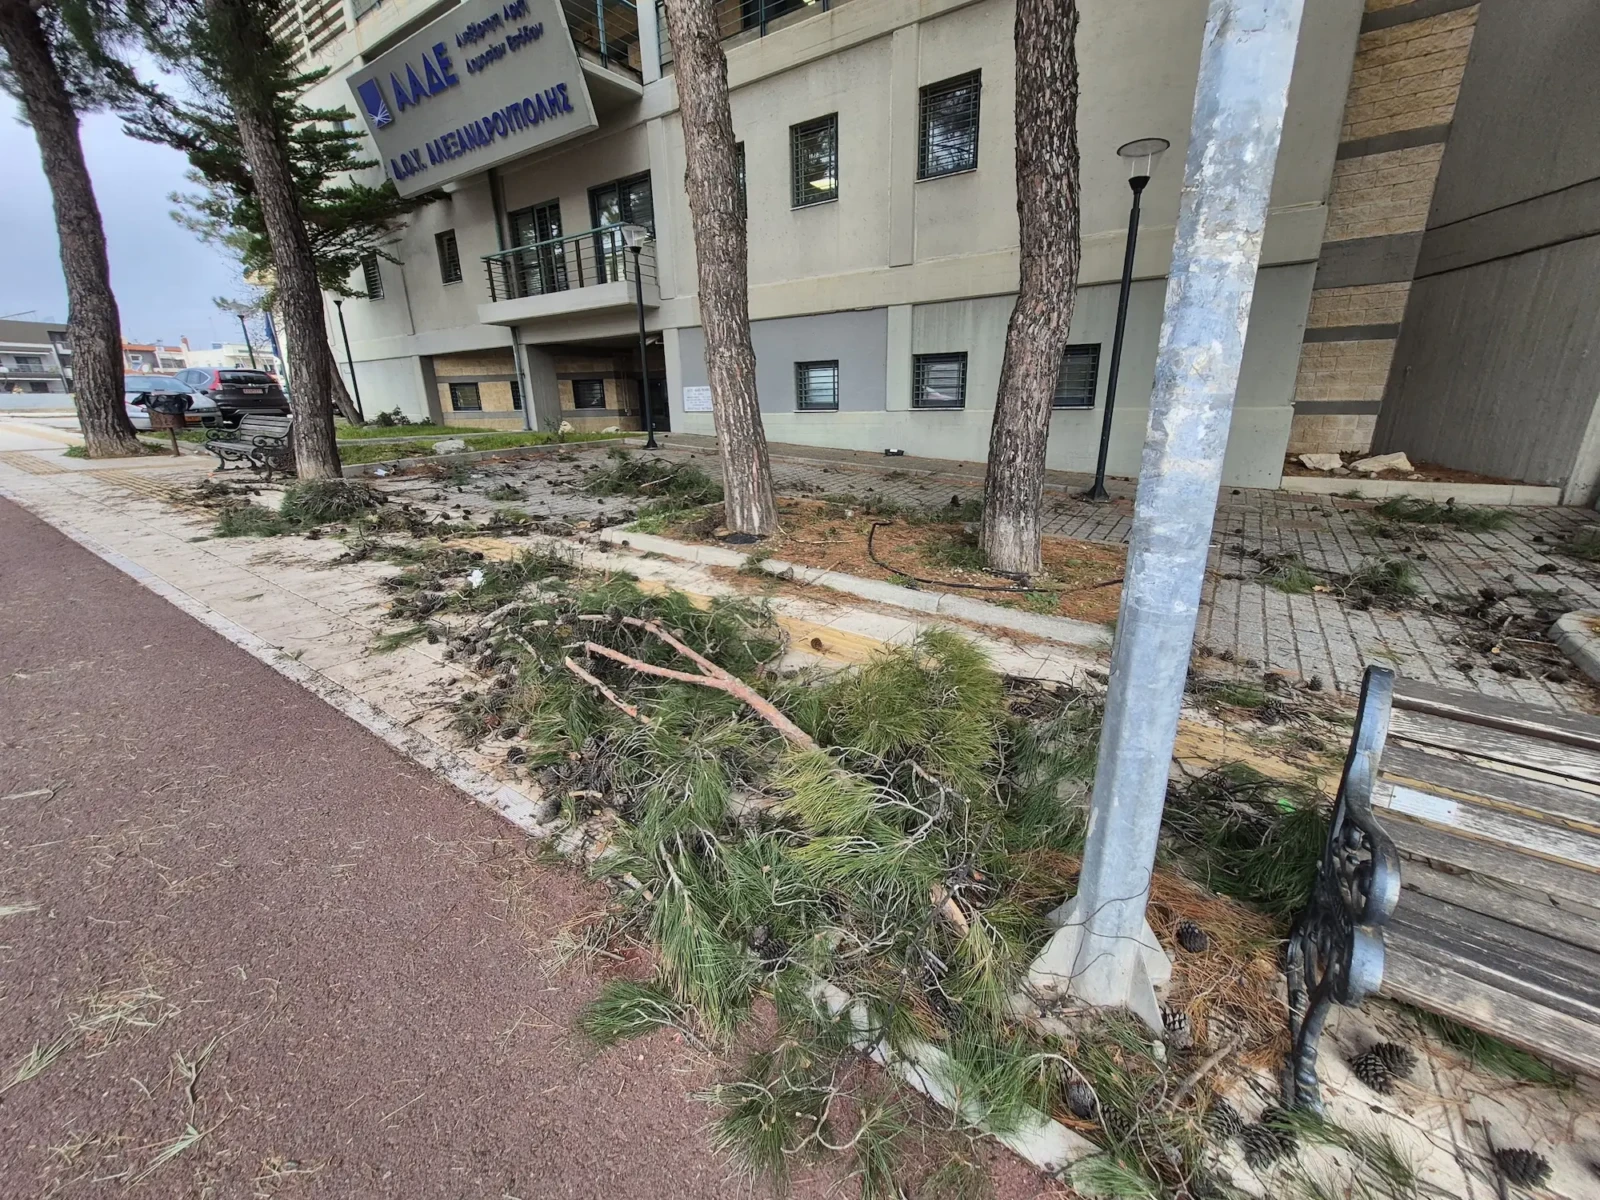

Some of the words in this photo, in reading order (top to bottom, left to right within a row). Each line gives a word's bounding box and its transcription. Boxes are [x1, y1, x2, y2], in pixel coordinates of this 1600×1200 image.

[389, 42, 459, 111] ΑΑΔΕ
[390, 148, 427, 180] Δ.Ο.Υ.
[426, 83, 574, 165] ΑΛΕΞΑΝΔΡΟΥΠΟΛΗΣ
